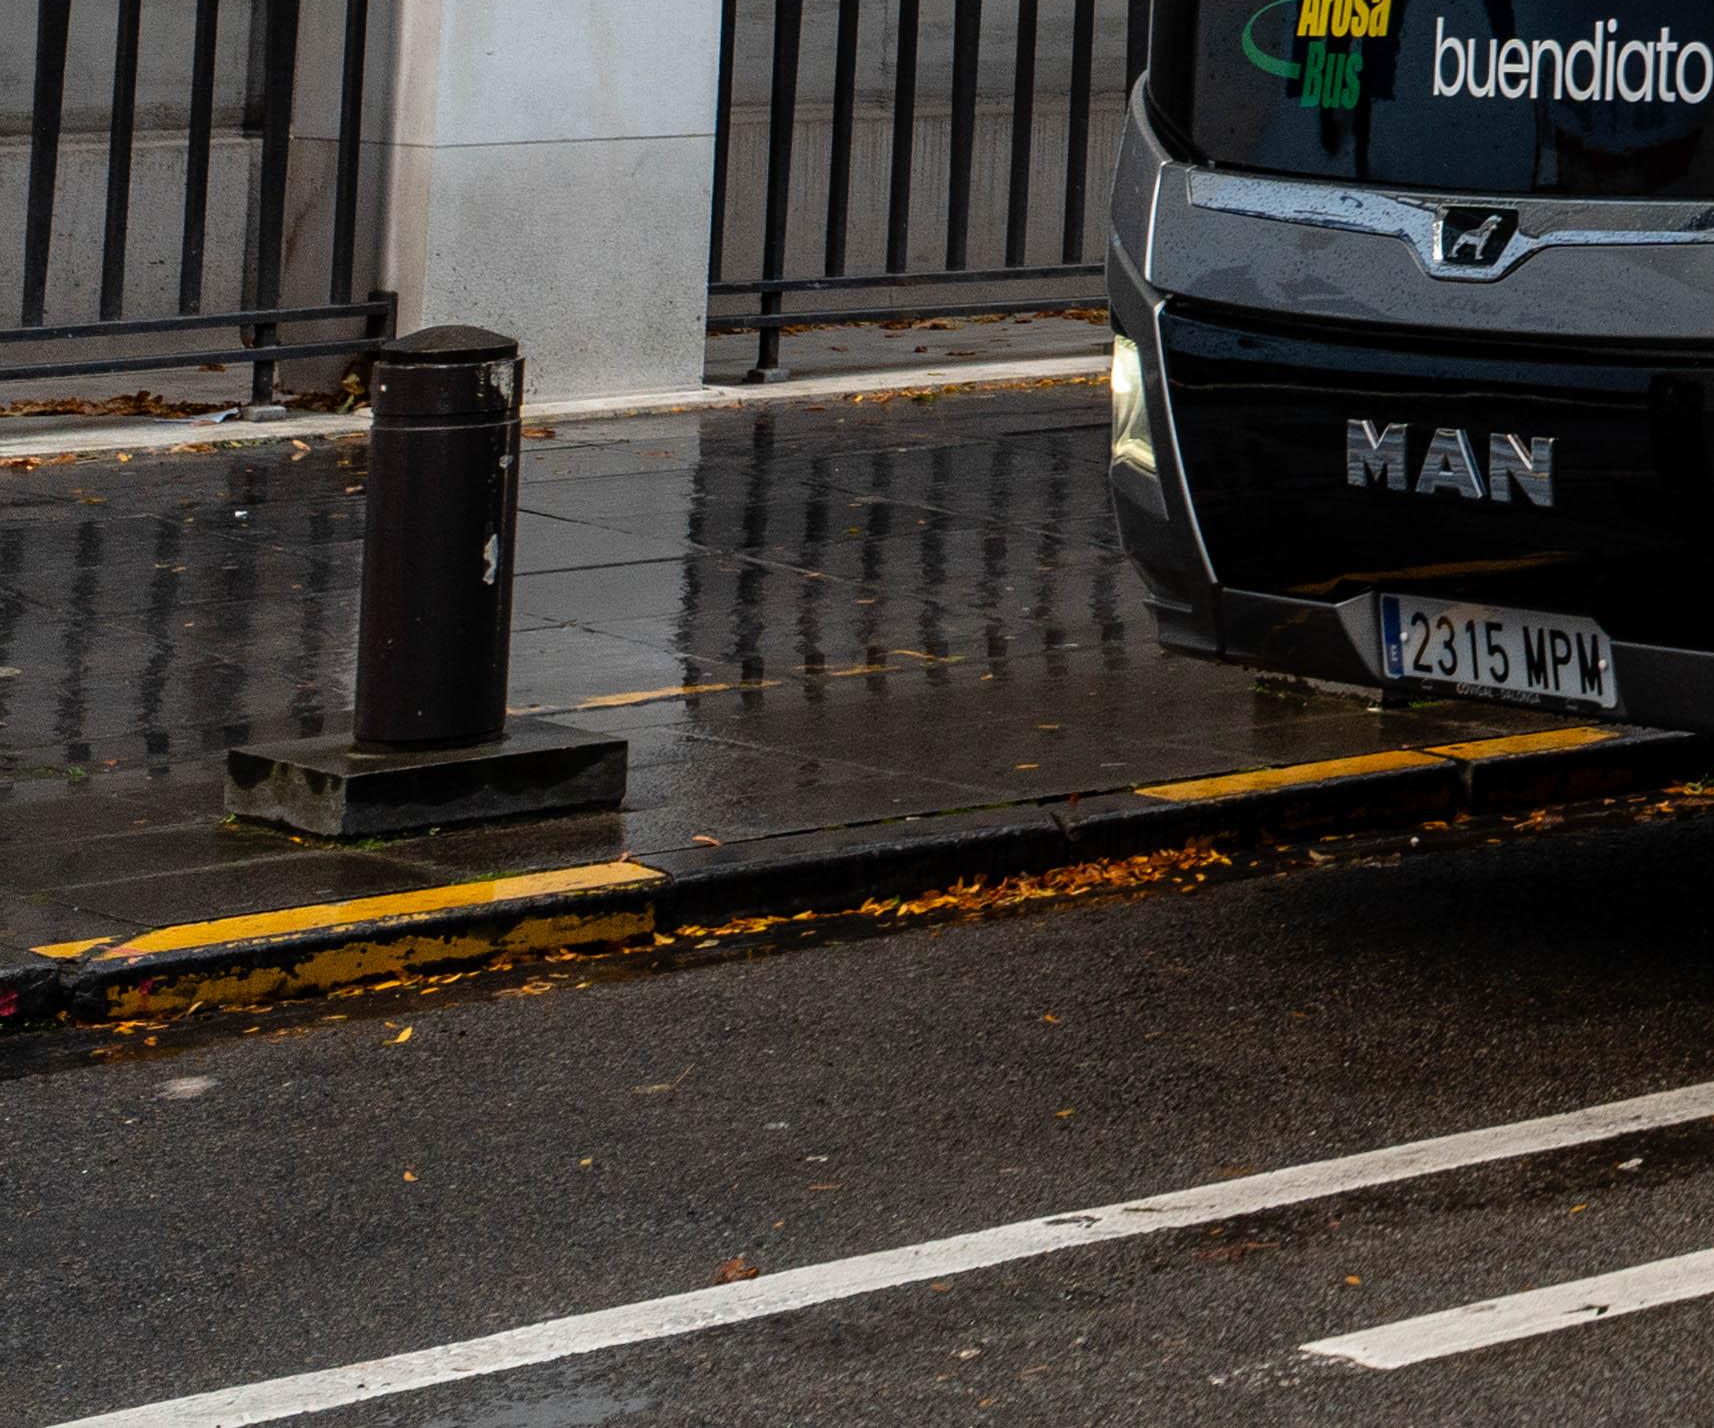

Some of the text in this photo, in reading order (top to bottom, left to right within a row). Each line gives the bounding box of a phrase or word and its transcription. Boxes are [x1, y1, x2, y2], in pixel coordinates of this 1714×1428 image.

[1300, 38, 1362, 110] Bus
[1346, 418, 1559, 507] MAN
[1411, 612, 1603, 697] 2315 MPM
